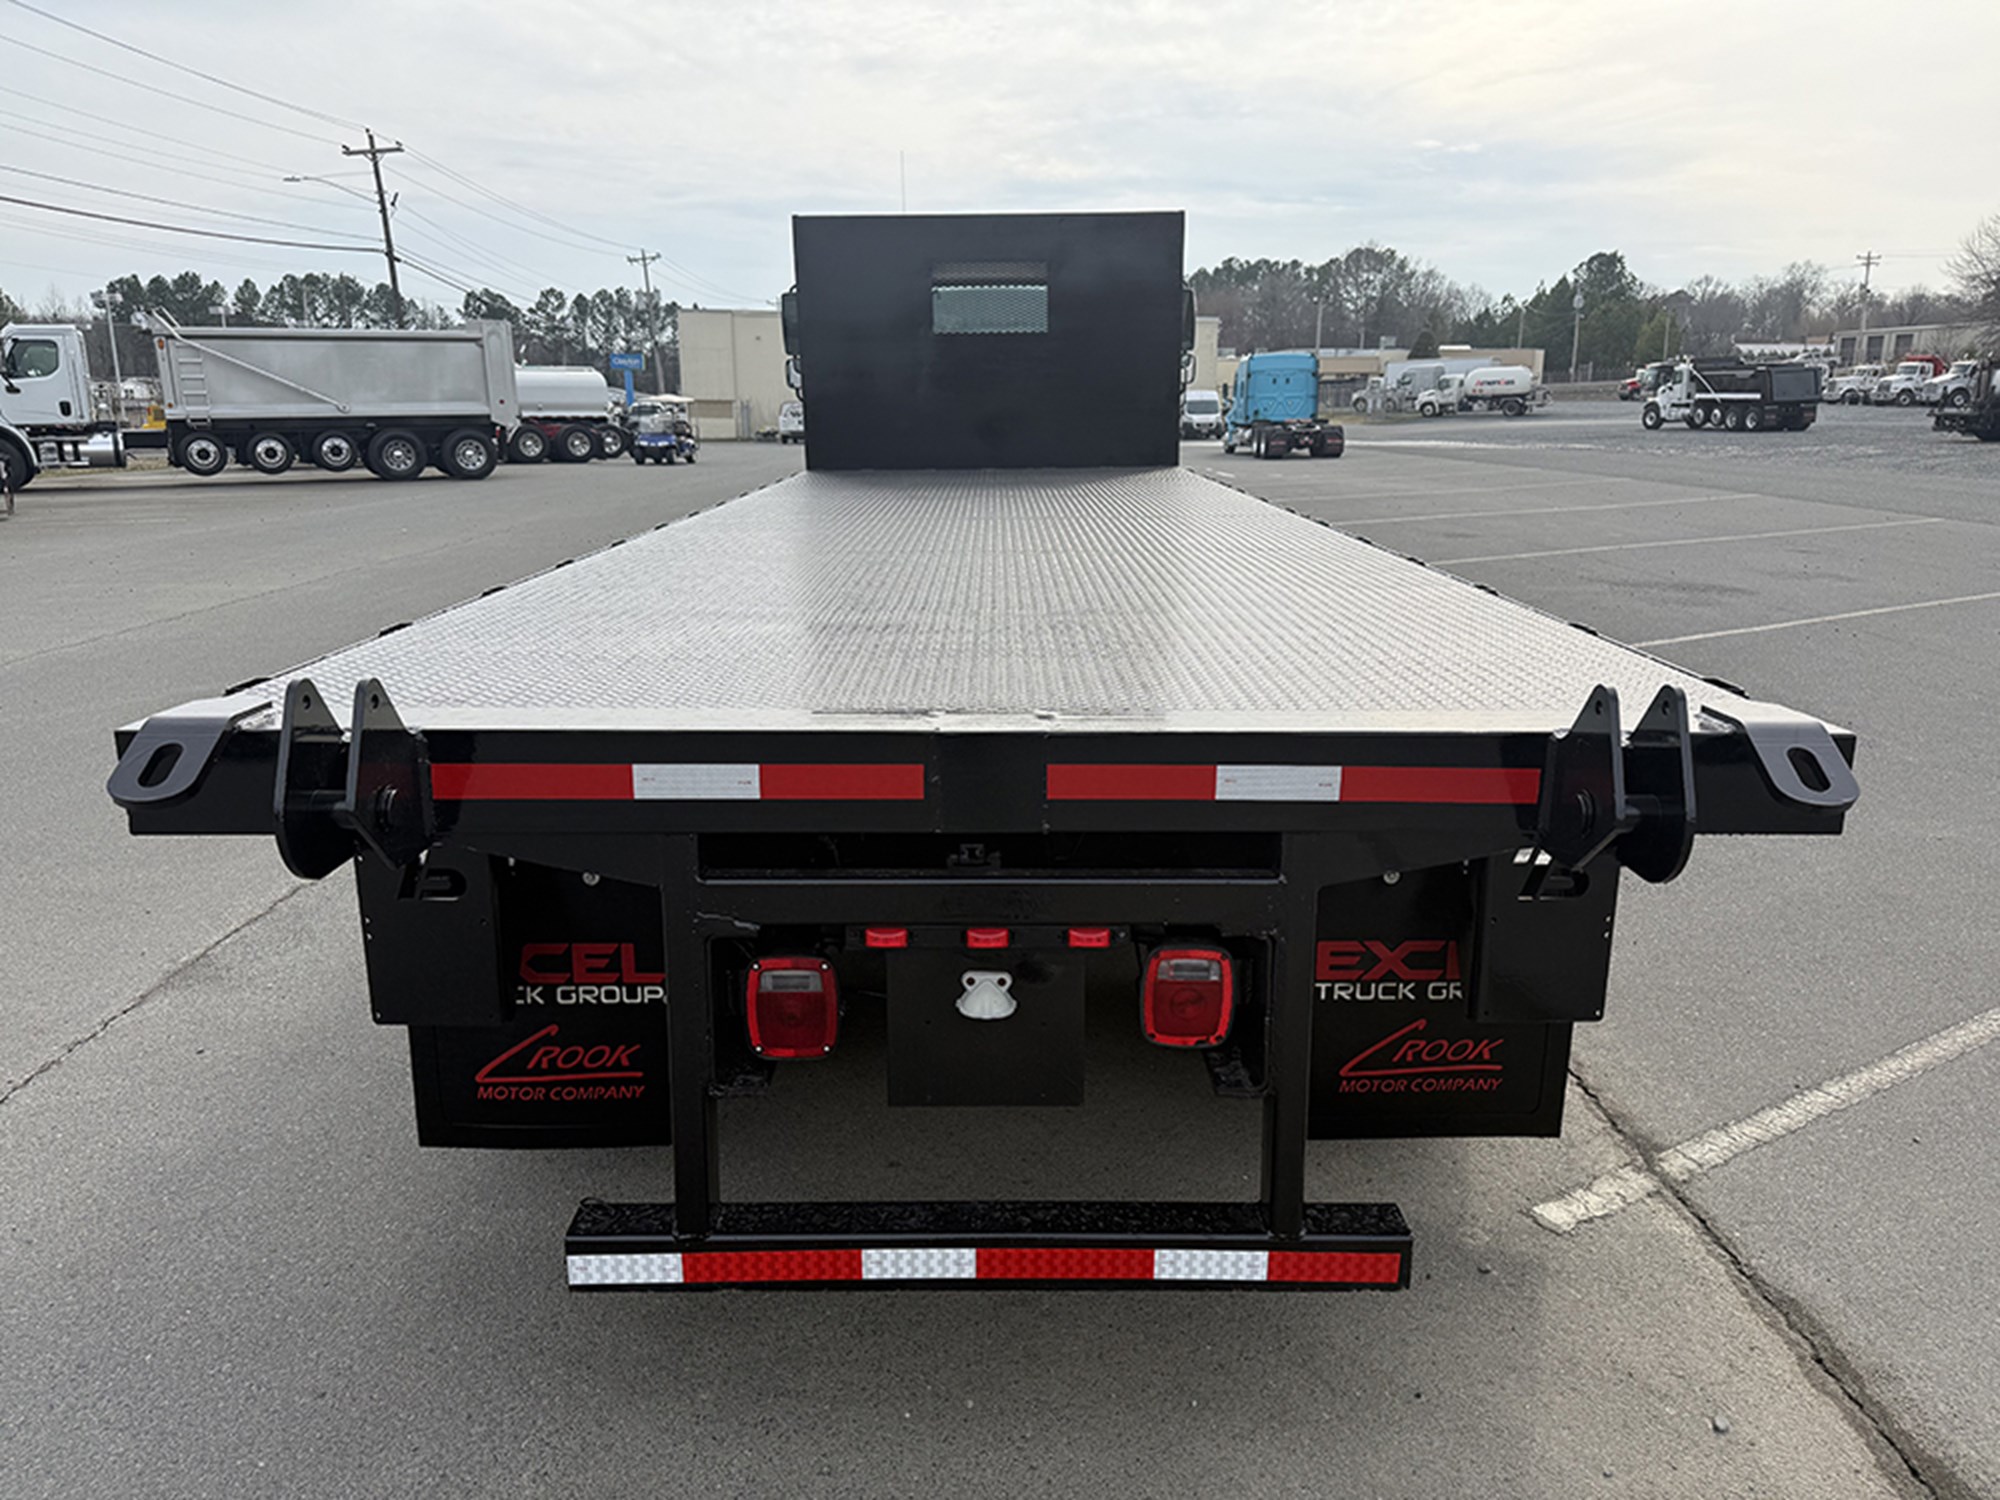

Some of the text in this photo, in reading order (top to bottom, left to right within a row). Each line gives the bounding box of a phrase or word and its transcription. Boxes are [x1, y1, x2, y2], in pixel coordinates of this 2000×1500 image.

[557, 986, 663, 1004] GROUP
[1315, 982, 1416, 1000] TRUCK
[477, 1085, 645, 1101] MOTOR COMPANY
[1339, 1078, 1503, 1093] MOTOR COMPANY
